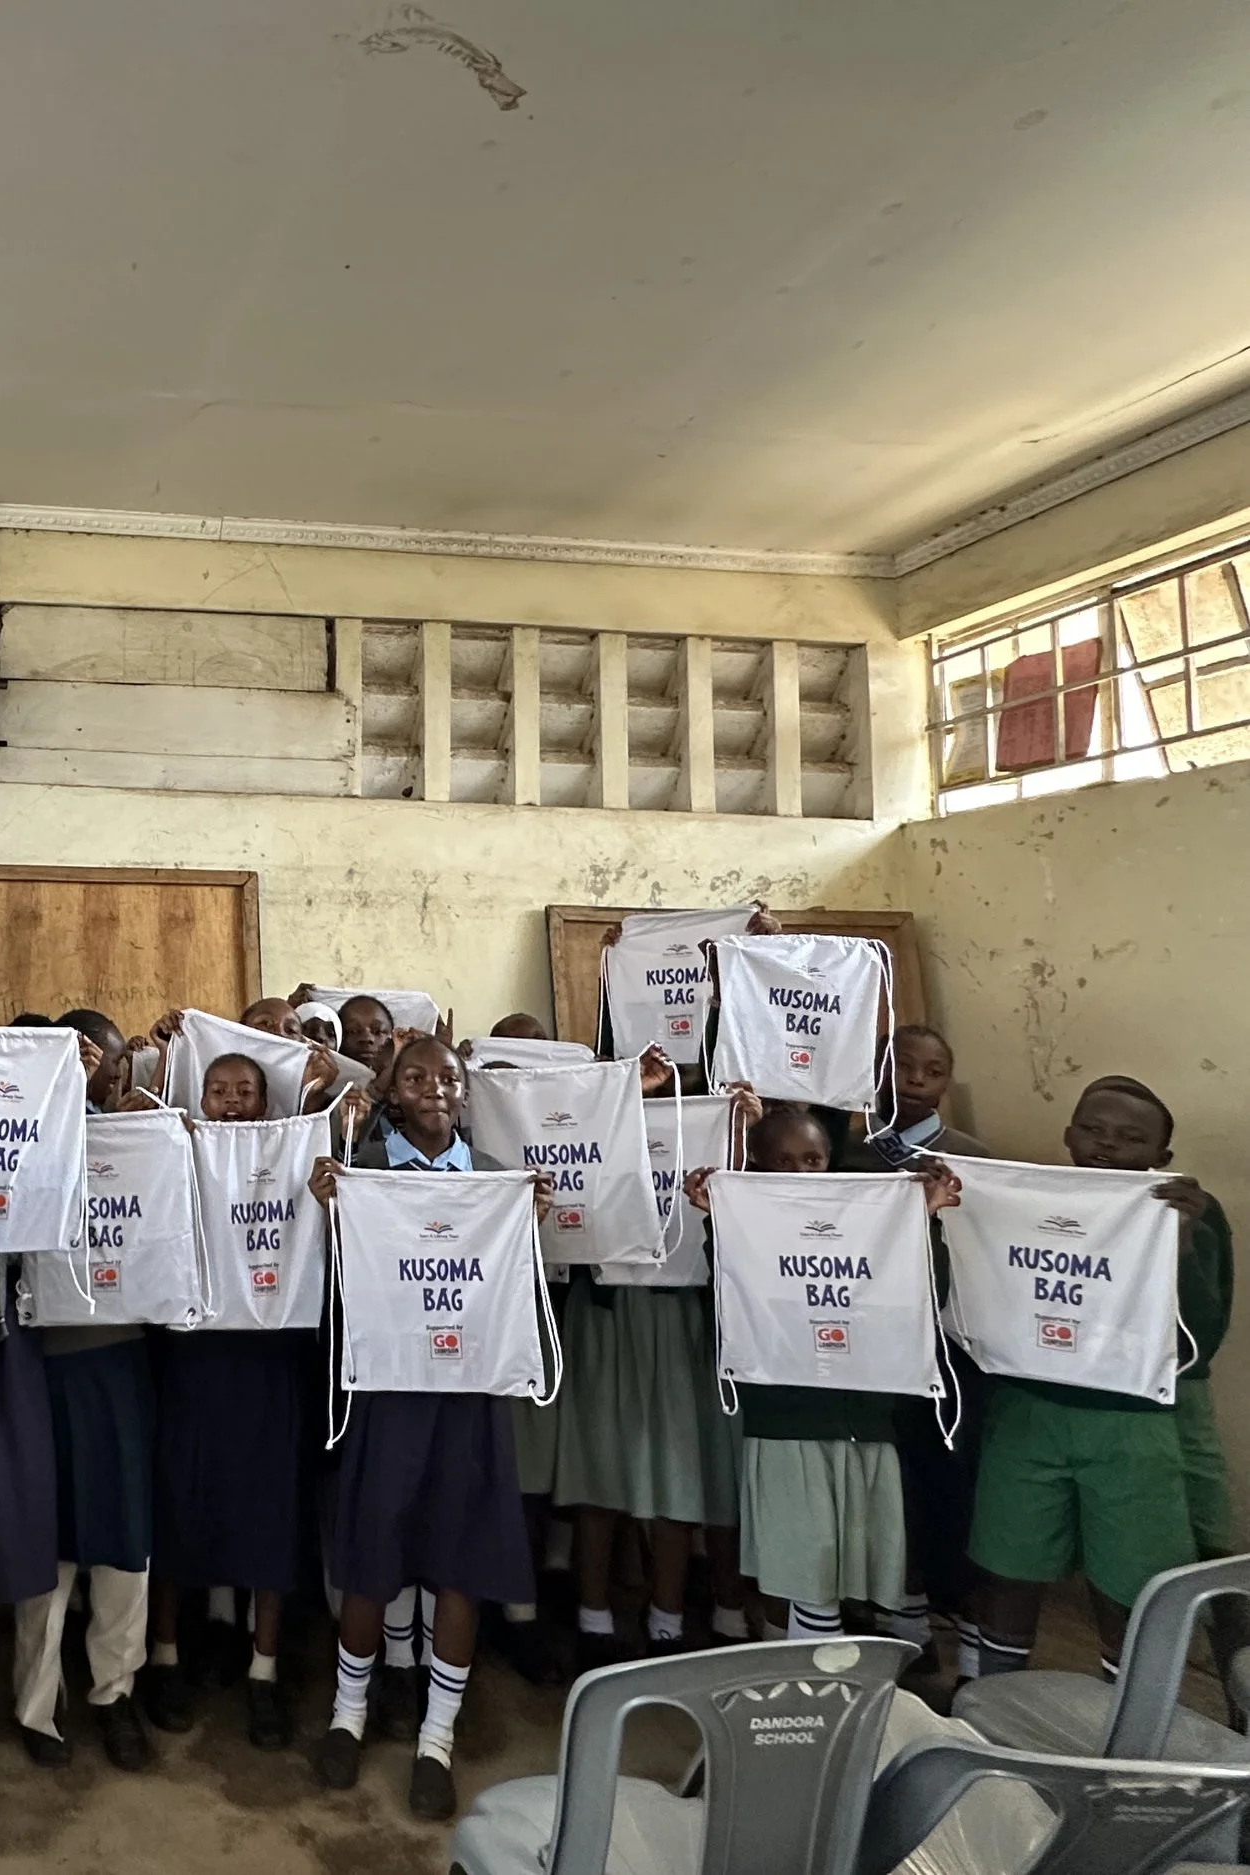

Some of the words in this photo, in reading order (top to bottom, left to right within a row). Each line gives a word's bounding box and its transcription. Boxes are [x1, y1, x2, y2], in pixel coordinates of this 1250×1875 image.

[664, 988, 695, 1005] BAG
[769, 986, 841, 1015] KUSOMA
[786, 1013, 821, 1035] BAG
[523, 1142, 602, 1165] KUSOMA
[88, 1195, 142, 1220] SOMA
[231, 1198, 296, 1224] KUSOMA
[88, 1225, 123, 1248] BAG
[246, 1228, 280, 1251] BAG
[399, 1258, 484, 1282] KUSOMA
[778, 1255, 872, 1279] KUSOMA
[1008, 1245, 1112, 1282] KUSOMA
[423, 1287, 463, 1311] BAG
[805, 1284, 851, 1308] BAG
[1034, 1277, 1083, 1306] BAG
[750, 1715, 825, 1730] DANDORA
[754, 1732, 816, 1746] SCHOOL
